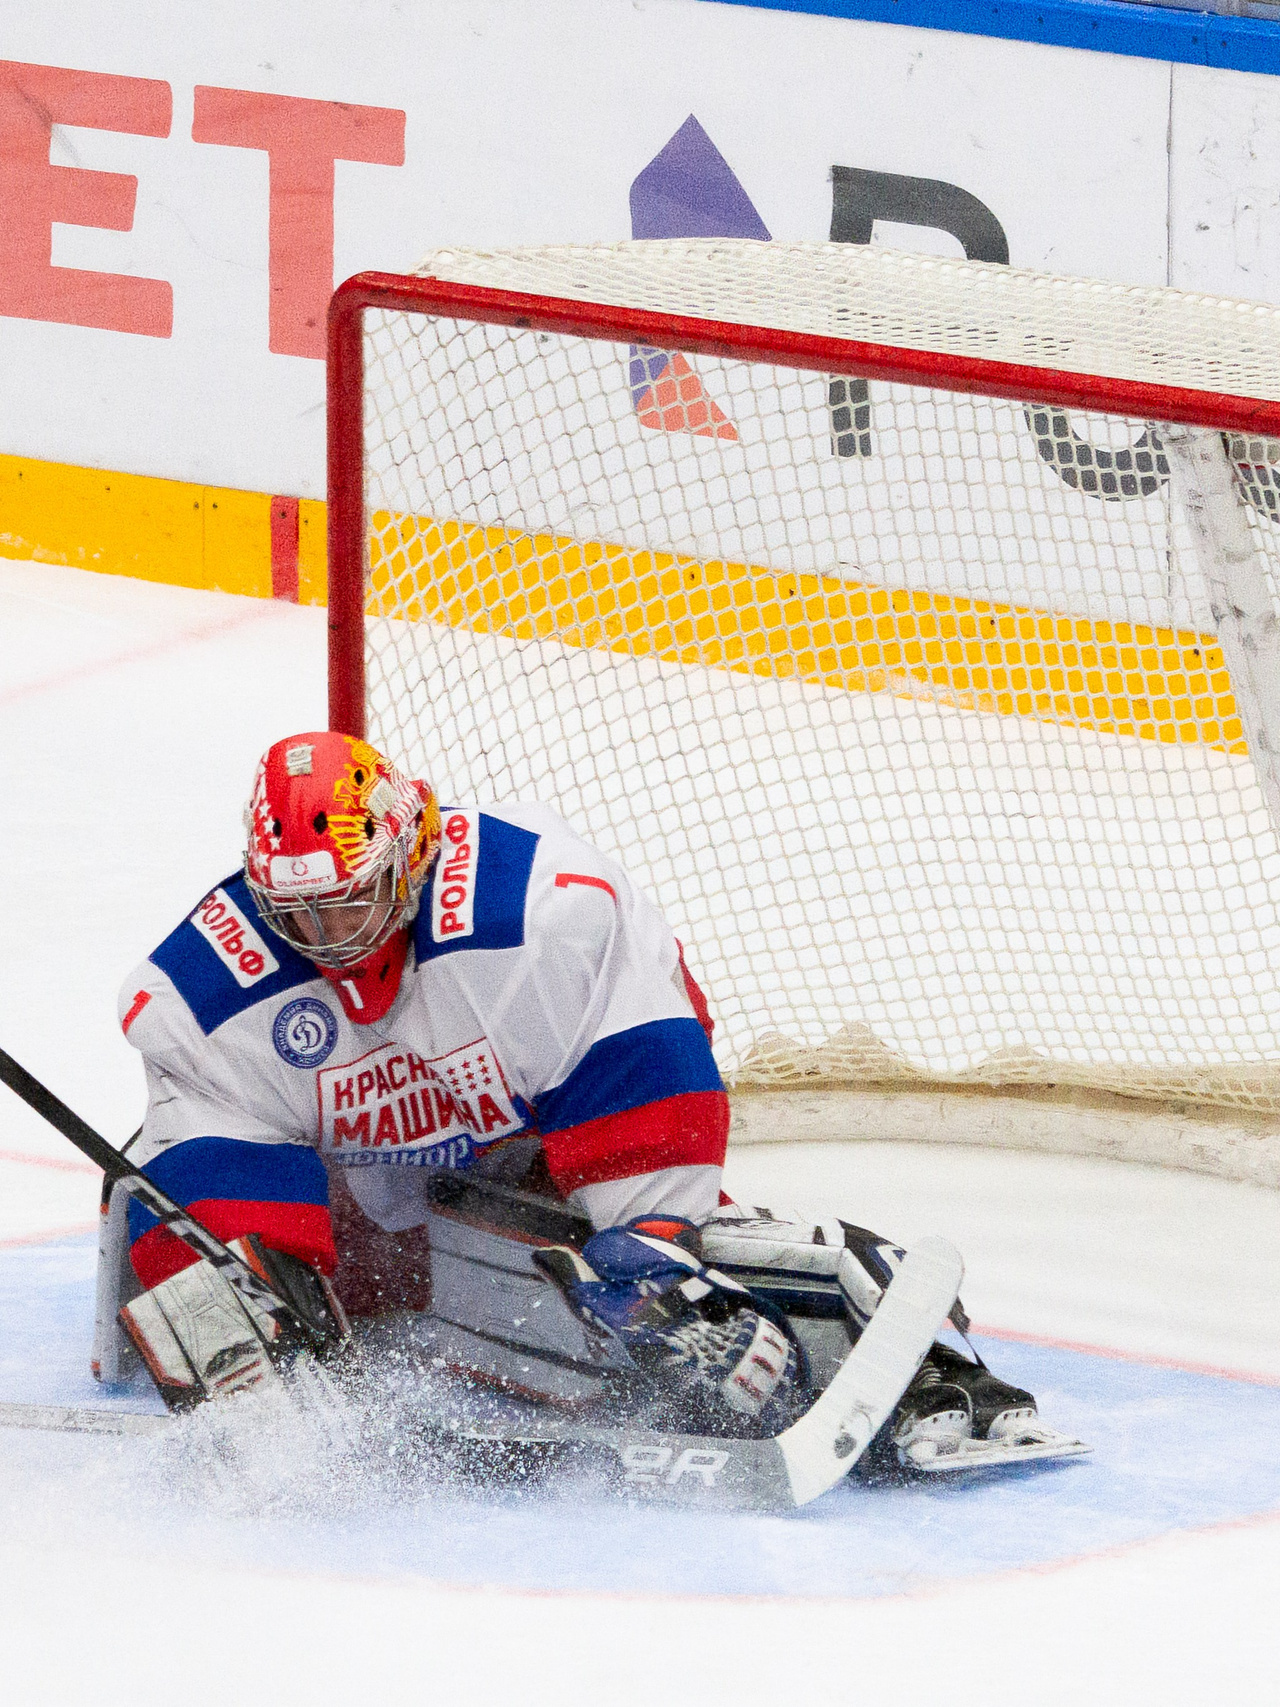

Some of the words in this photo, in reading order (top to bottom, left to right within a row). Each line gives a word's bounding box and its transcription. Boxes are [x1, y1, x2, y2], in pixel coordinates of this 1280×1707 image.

[440, 814, 471, 936] РОЛЬФ
[554, 873, 617, 908] 1
[122, 990, 152, 1035] 1
[341, 980, 363, 1009] 1
[334, 1052, 444, 1112] КРАСН
